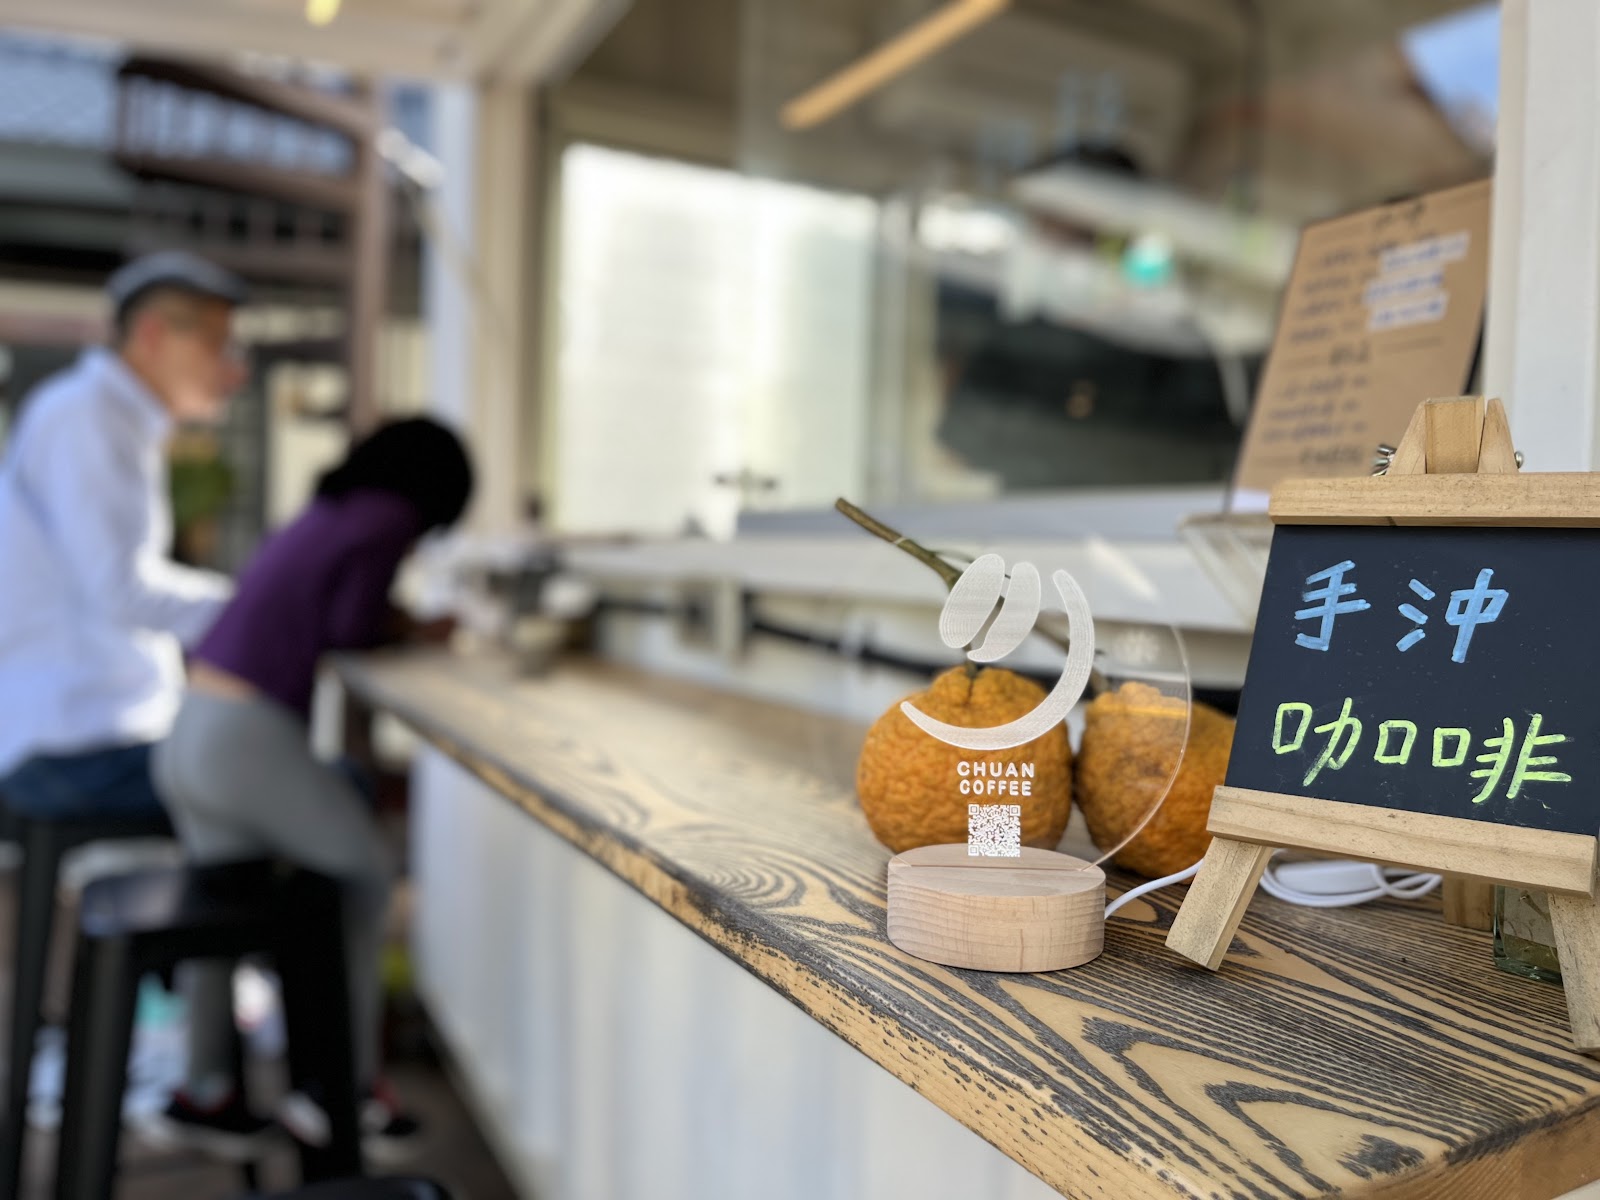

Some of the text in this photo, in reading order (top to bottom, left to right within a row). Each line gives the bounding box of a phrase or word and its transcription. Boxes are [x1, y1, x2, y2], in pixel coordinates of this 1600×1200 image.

[1271, 697, 1572, 803] 咖啡
[956, 761, 1035, 778] CHUAN
[959, 779, 1032, 796] COFFEE
